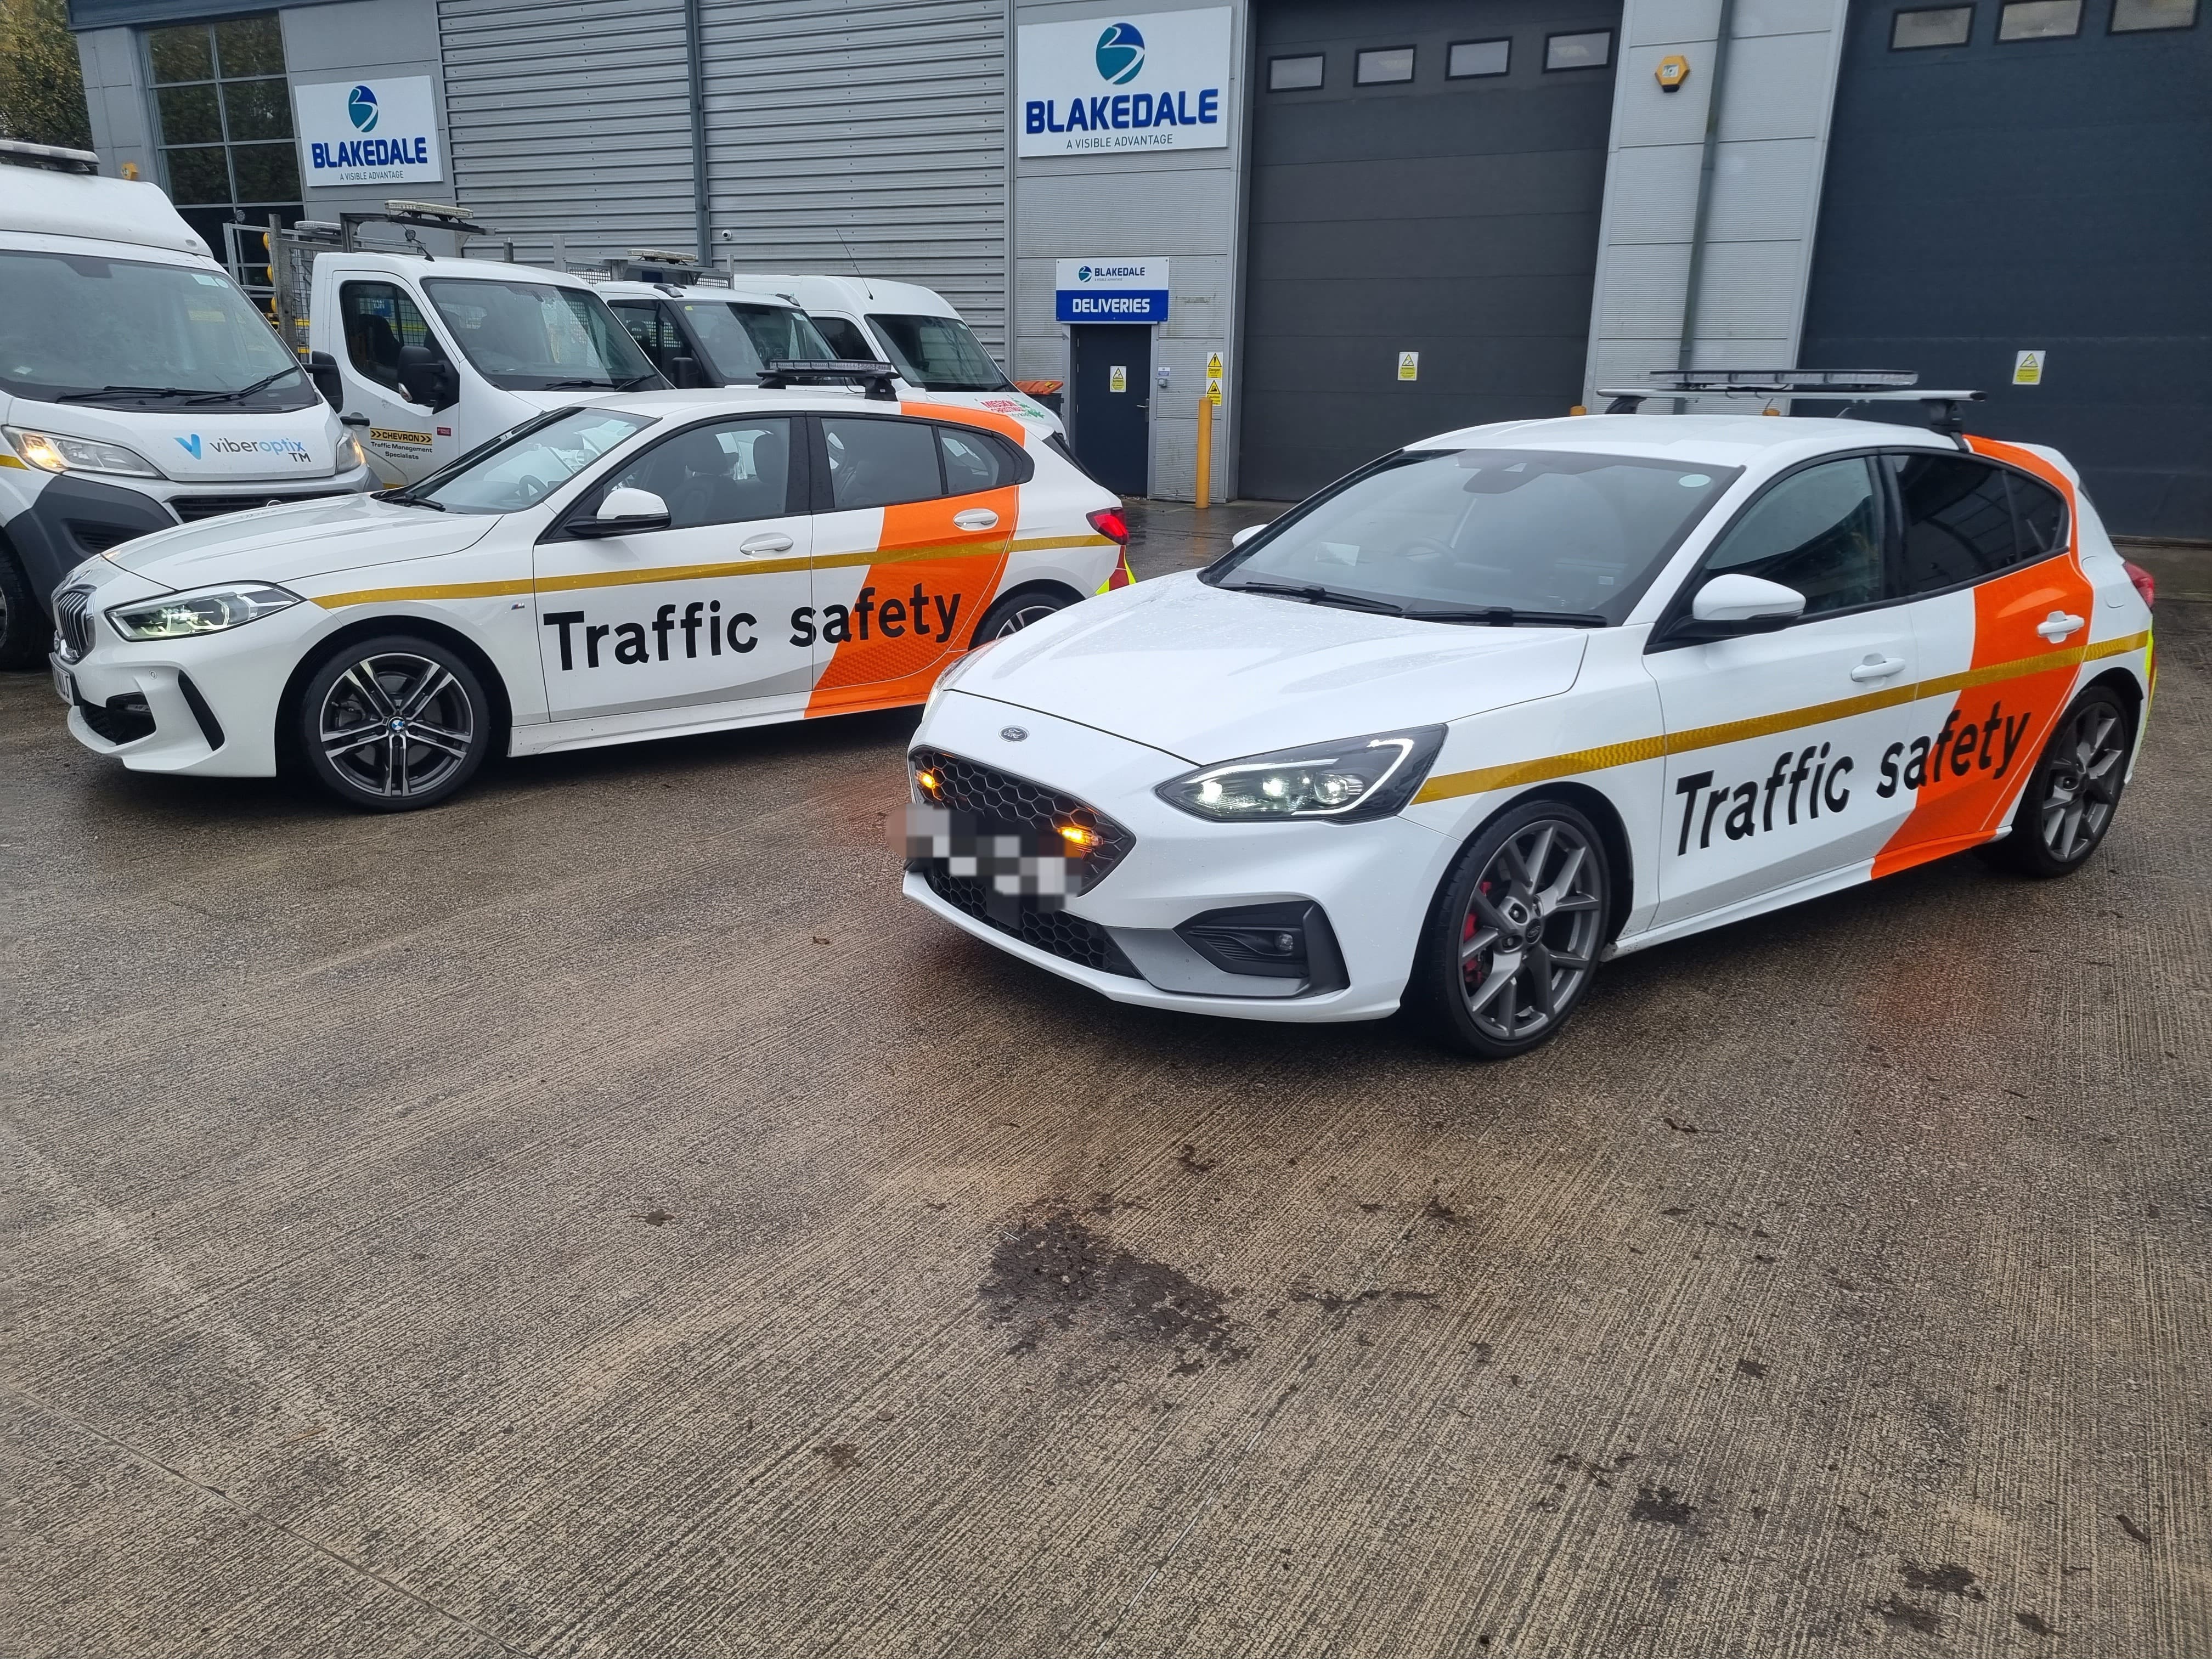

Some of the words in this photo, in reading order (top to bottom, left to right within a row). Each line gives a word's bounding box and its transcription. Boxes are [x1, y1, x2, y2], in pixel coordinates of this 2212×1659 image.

[1026, 88, 1218, 134] BLAKEDALE
[1066, 139, 1073, 149] A
[1075, 137, 1111, 149] VISIBLE
[1114, 134, 1173, 147] ADVANTAGE
[311, 137, 428, 168] BLAKEDALE
[340, 172, 344, 180] A
[345, 172, 367, 180] VISIBLE
[369, 171, 404, 180] ADVANTAGE
[1094, 267, 1146, 276] BLAKEDALE
[1073, 298, 1150, 313] DELIVERIES
[382, 432, 420, 442] CHEVRON
[210, 438, 306, 455] viberoptix
[392, 444, 433, 453] Management
[288, 453, 312, 462] TM
[385, 452, 419, 460] Specialists
[543, 599, 759, 671] Traffic
[789, 583, 962, 647] safety
[1676, 741, 1854, 856] Traffic
[1876, 701, 2032, 799] safety
